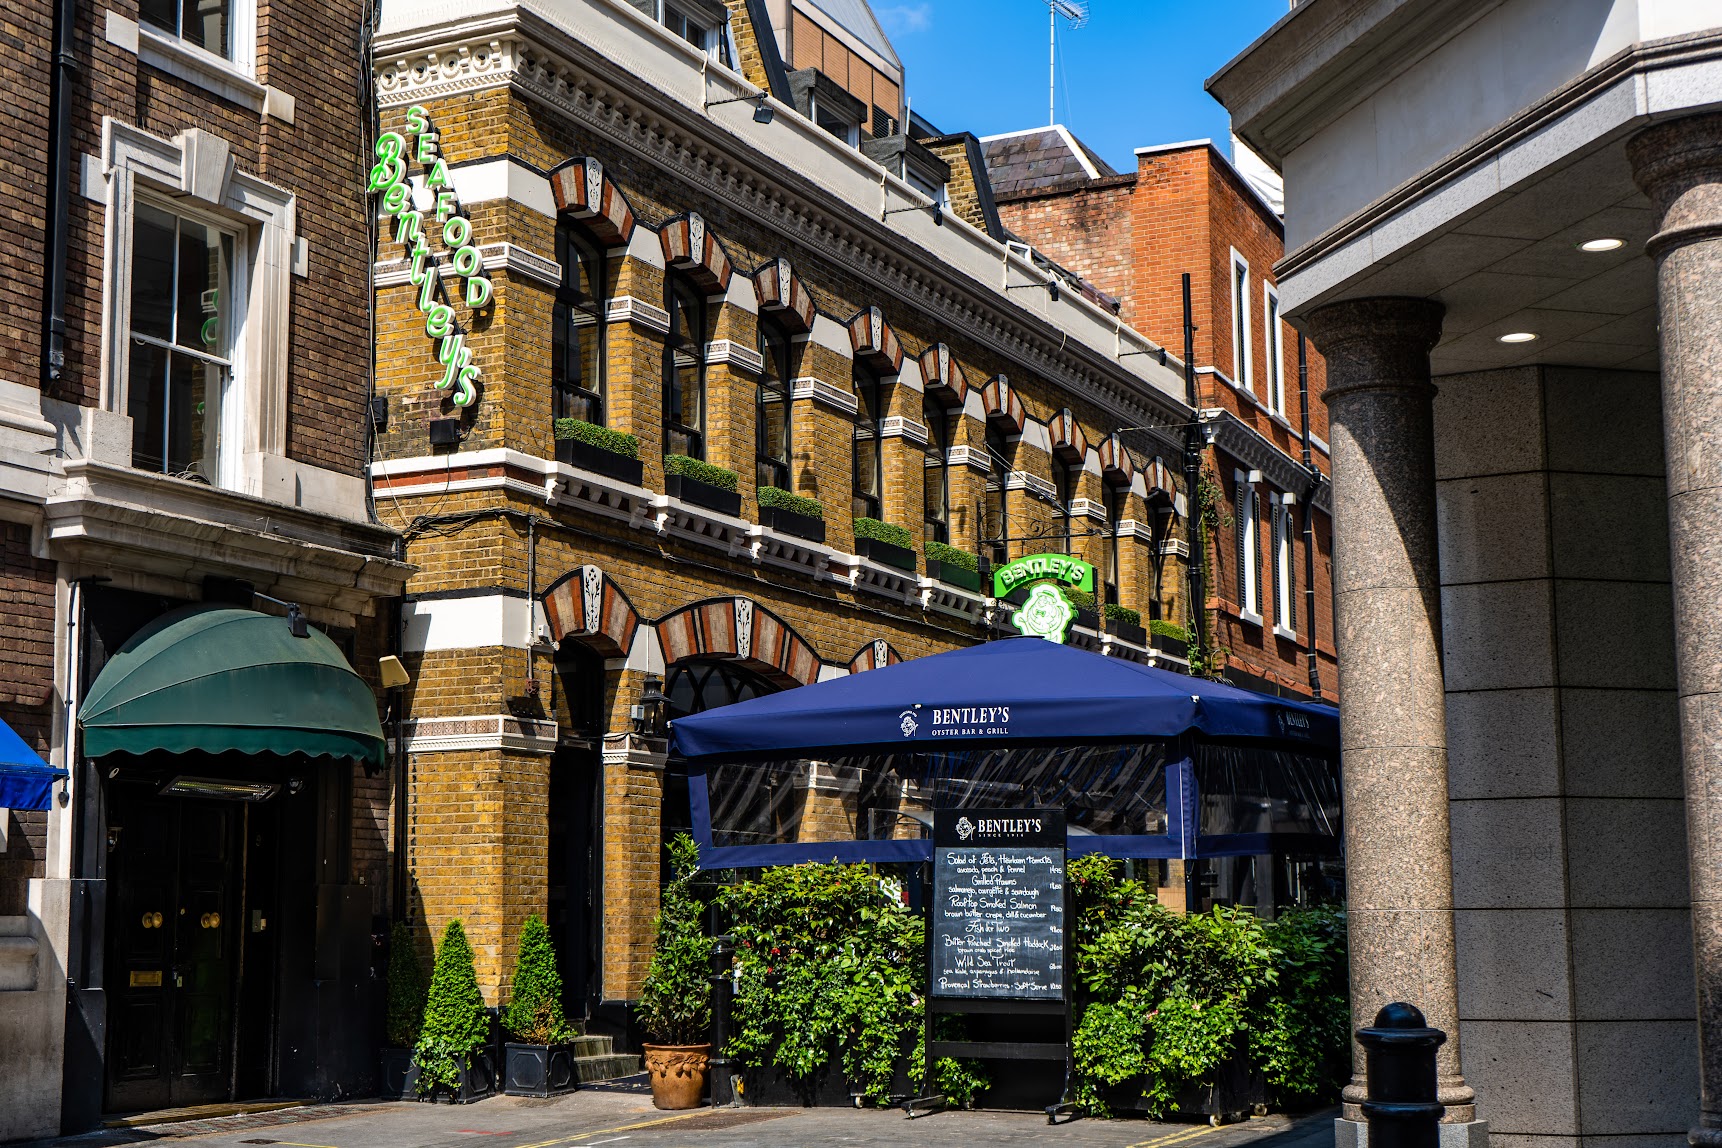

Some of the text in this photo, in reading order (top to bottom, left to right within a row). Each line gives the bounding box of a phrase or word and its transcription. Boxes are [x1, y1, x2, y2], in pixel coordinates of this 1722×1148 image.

[406, 105, 493, 308] SEAFOOD
[367, 132, 482, 408] Bentley's
[1000, 557, 1085, 587] BENTLEY'S
[932, 706, 1010, 725] BENTLEY'S
[931, 729, 959, 737] OYSTER
[986, 727, 1009, 735] GRILL
[977, 818, 1042, 833] BENTLEY'S
[946, 852, 967, 865] Salad
[968, 854, 977, 864] of
[981, 866, 998, 875] peach
[999, 865, 1005, 873] &
[971, 874, 1017, 886] Grilled Prawns
[977, 886, 1004, 897] courgette
[1004, 886, 1010, 895] &
[1011, 886, 1040, 899] sourdough
[979, 897, 1007, 909] Smoked
[1009, 898, 1037, 909] Salmon
[944, 909, 963, 918] brown
[964, 909, 983, 918] butter
[965, 919, 984, 933] Fish
[991, 921, 1010, 933] Two
[996, 937, 1021, 948] Smoked
[1023, 937, 1050, 949] Haddock
[954, 953, 1016, 968] Wild Sea Trout
[1030, 982, 1047, 990] Serve
